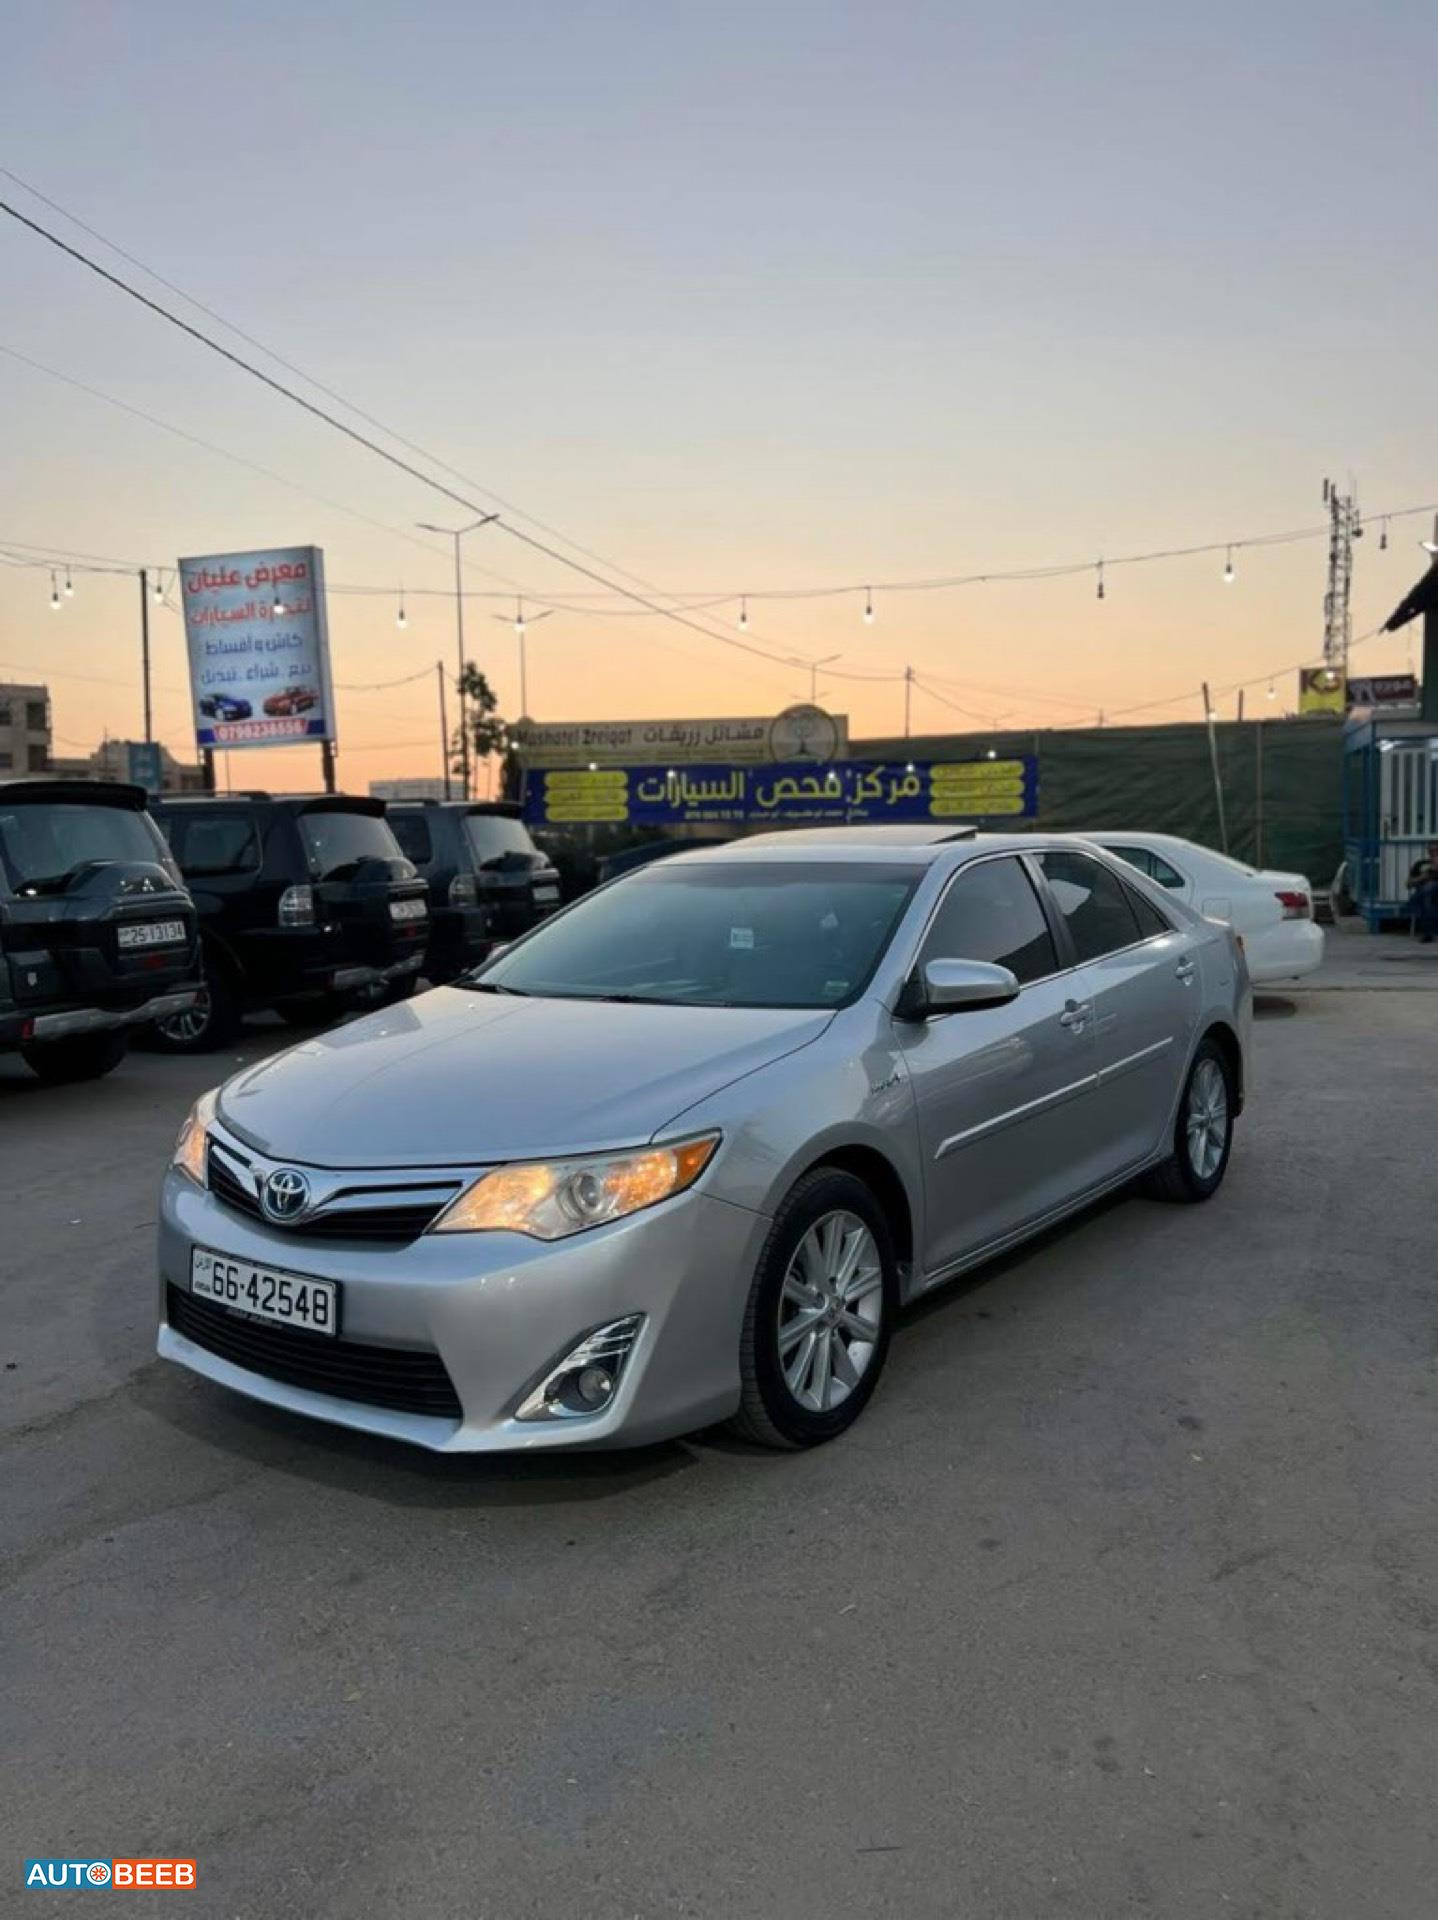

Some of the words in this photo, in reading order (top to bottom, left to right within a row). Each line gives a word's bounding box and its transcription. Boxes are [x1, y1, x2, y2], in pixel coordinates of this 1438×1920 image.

[244, 560, 307, 589] معرض
[189, 600, 256, 627] السيارات
[636, 770, 745, 808] السيارات
[755, 769, 842, 808] فحص
[852, 765, 921, 806] مركز
